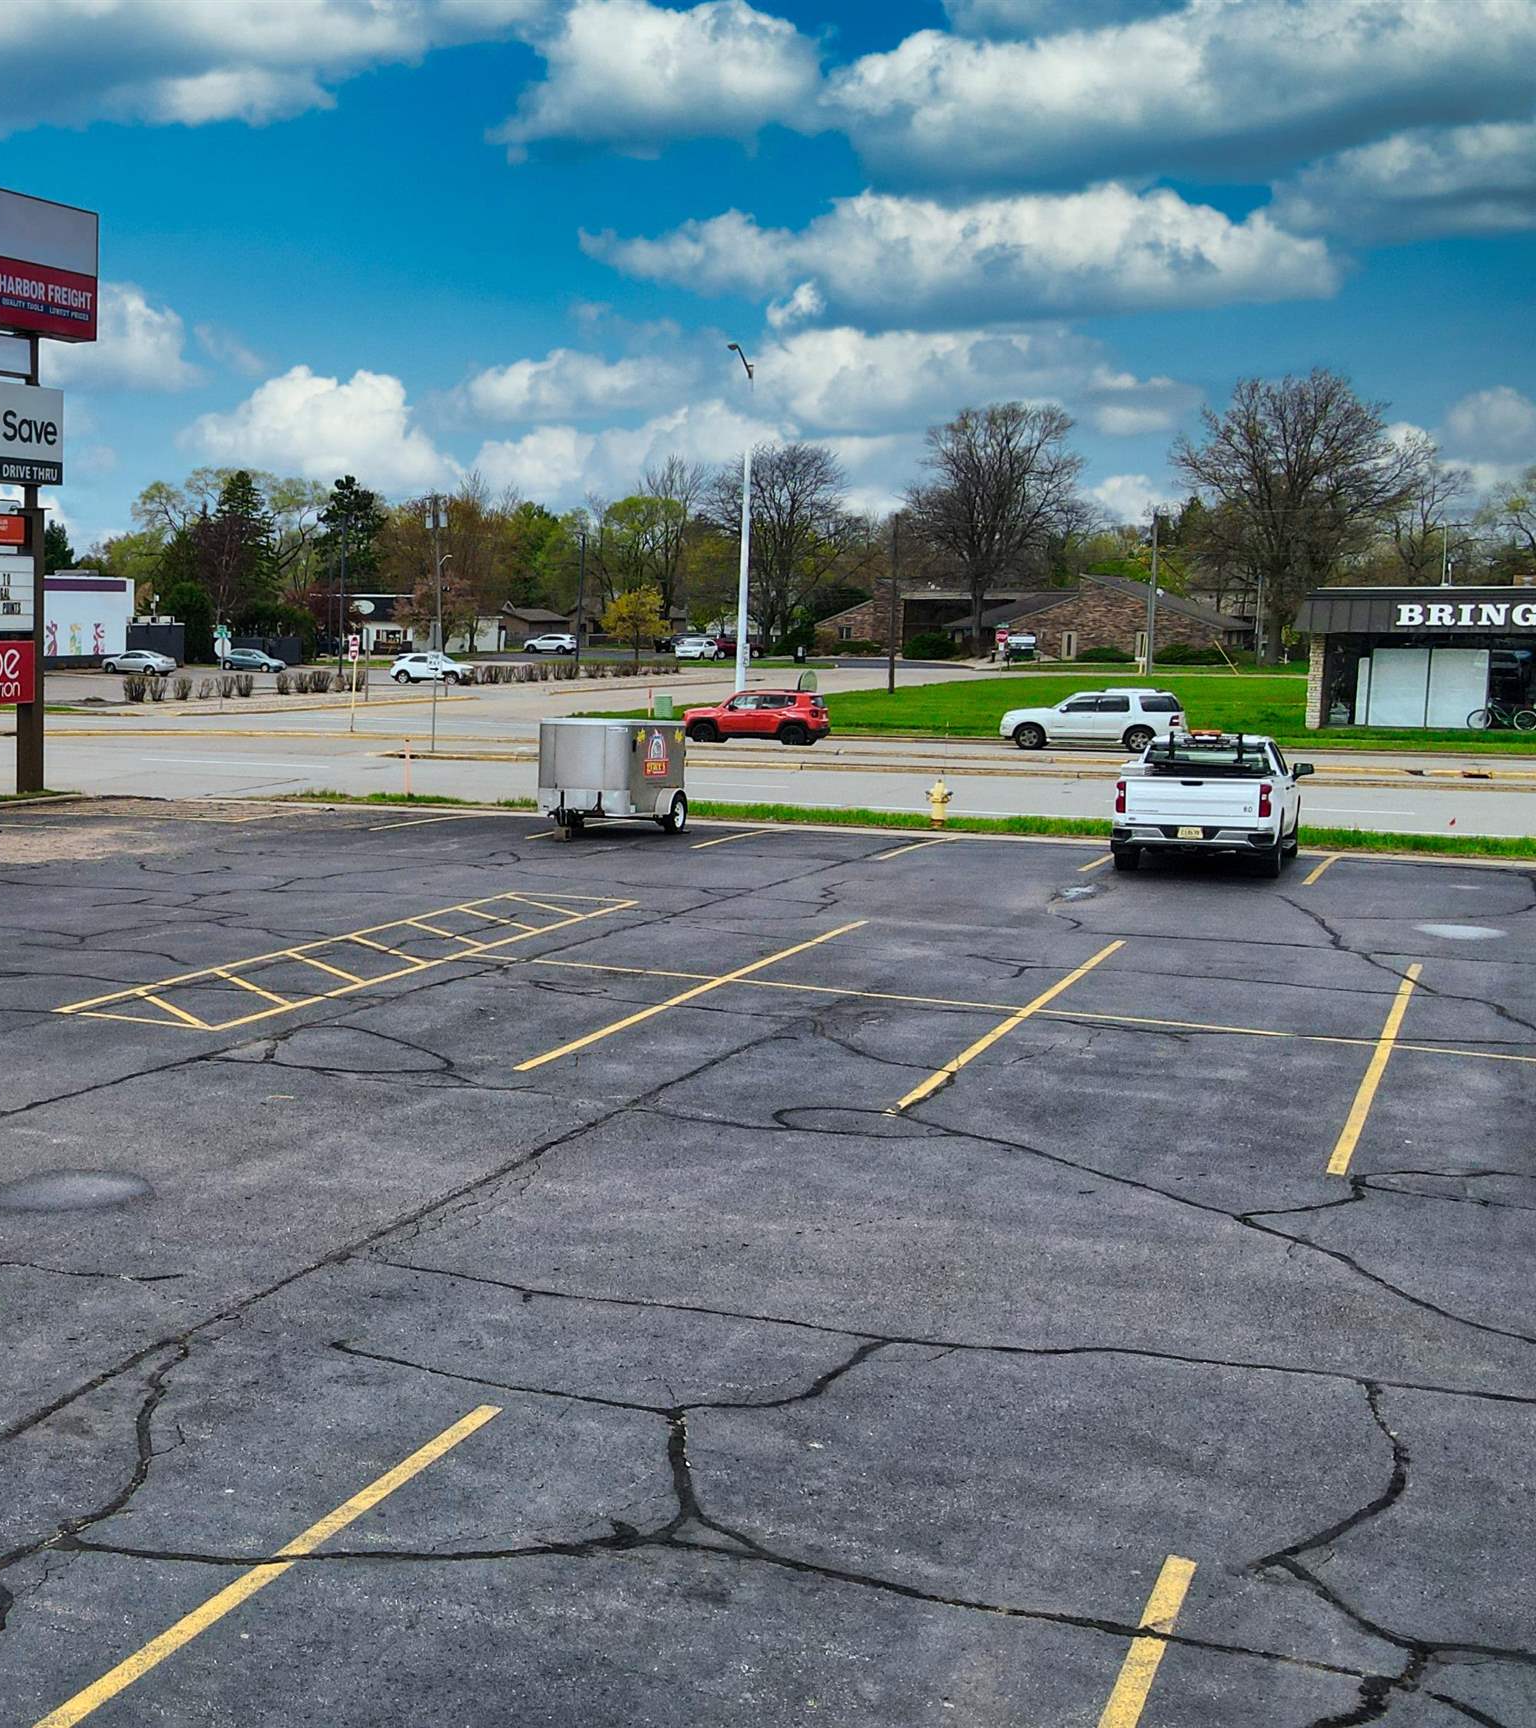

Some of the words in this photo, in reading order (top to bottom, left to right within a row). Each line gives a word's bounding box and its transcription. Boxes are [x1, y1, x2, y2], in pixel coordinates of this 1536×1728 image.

[47, 284, 92, 310] FREIGHT
[2, 410, 58, 446] Save
[2, 463, 32, 479] DRIVE
[32, 466, 58, 482] THRU
[1395, 603, 1536, 627] BRING
